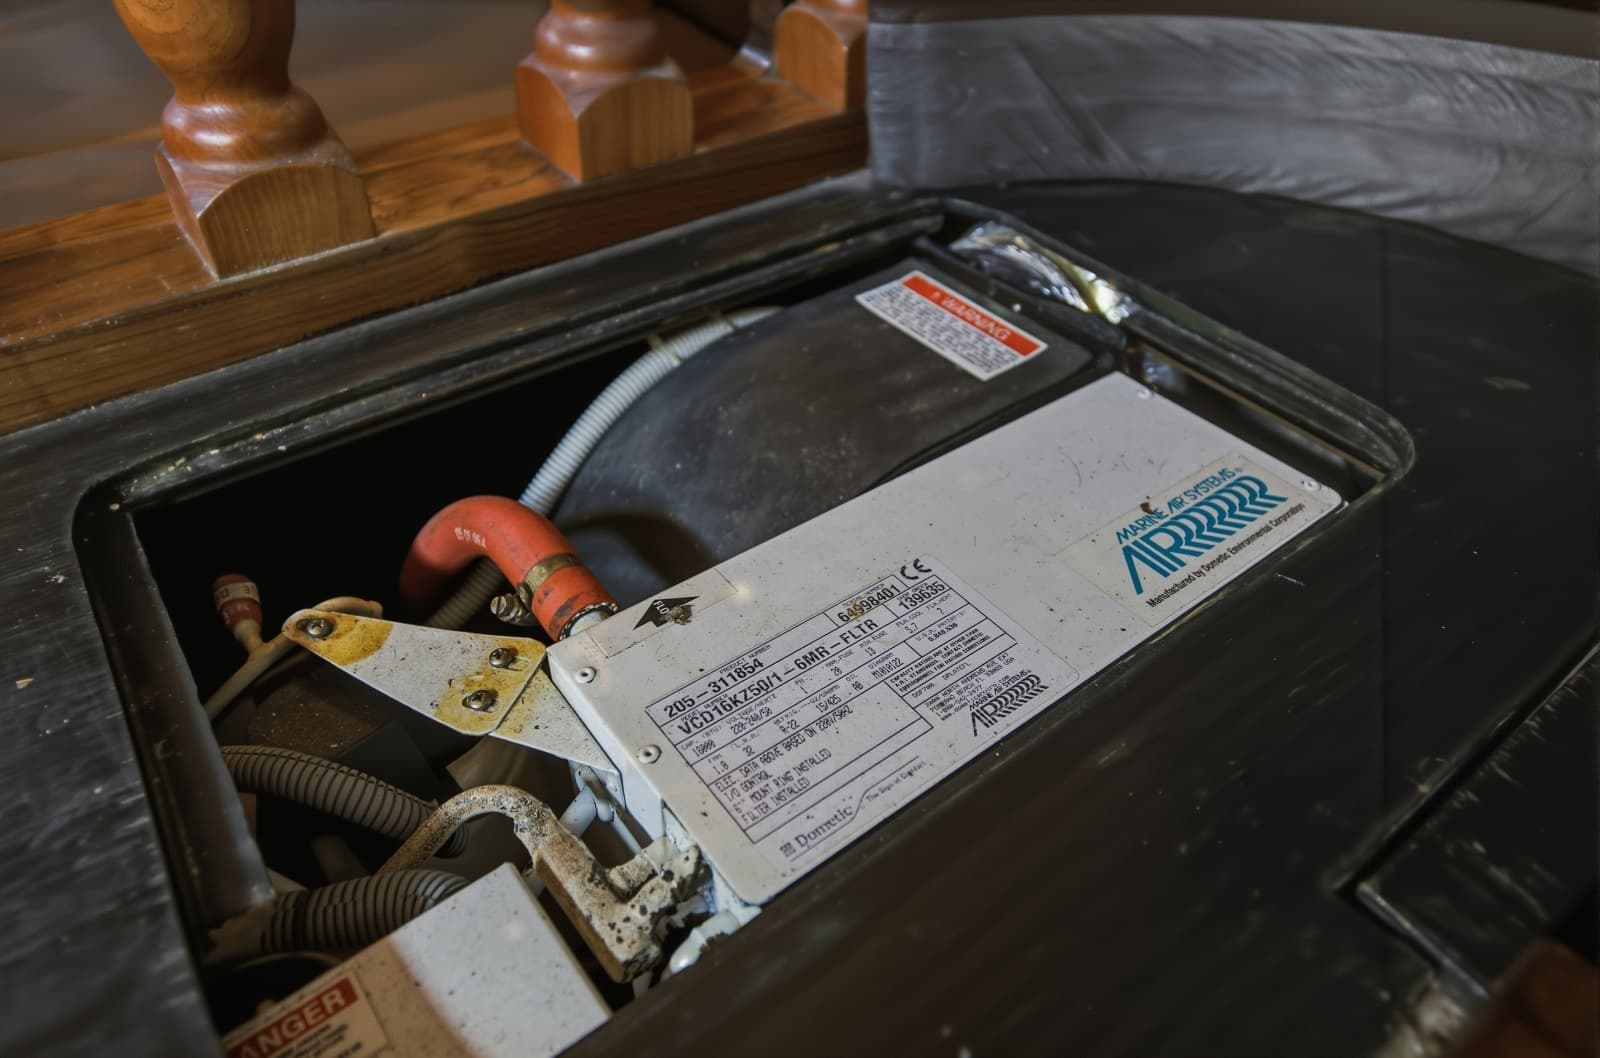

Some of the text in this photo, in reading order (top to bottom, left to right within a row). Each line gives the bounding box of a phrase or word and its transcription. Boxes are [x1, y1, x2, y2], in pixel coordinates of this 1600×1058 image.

[941, 296, 1012, 342] WARNING
[1116, 468, 1236, 544] MARINE AIR SYSTEMS
[899, 558, 932, 580] CE
[1146, 503, 1305, 607] Manufactured by Dometic Environmental Corporation
[837, 584, 900, 622] 64998401
[898, 581, 945, 610] 139635
[889, 666, 914, 683] CAPACITY
[965, 628, 978, 637] THAN
[940, 644, 963, 659] CONTACT
[815, 694, 842, 713] 15/425
[969, 692, 994, 711] MARINE
[1001, 669, 1028, 687] SYSTEMS
[778, 718, 800, 734] R-22
[714, 775, 740, 792] ELEC.
[739, 761, 759, 778] DATA
[759, 746, 784, 765] ABOVE
[781, 733, 806, 752] BASED
[804, 726, 817, 738] ON
[749, 783, 770, 801] MOUNT
[772, 770, 794, 788] RING
[792, 748, 832, 776] INSTALLED
[741, 776, 810, 824] FILTER INSTALLED
[794, 806, 853, 847] Dometic
[238, 986, 348, 1058] ANGER
